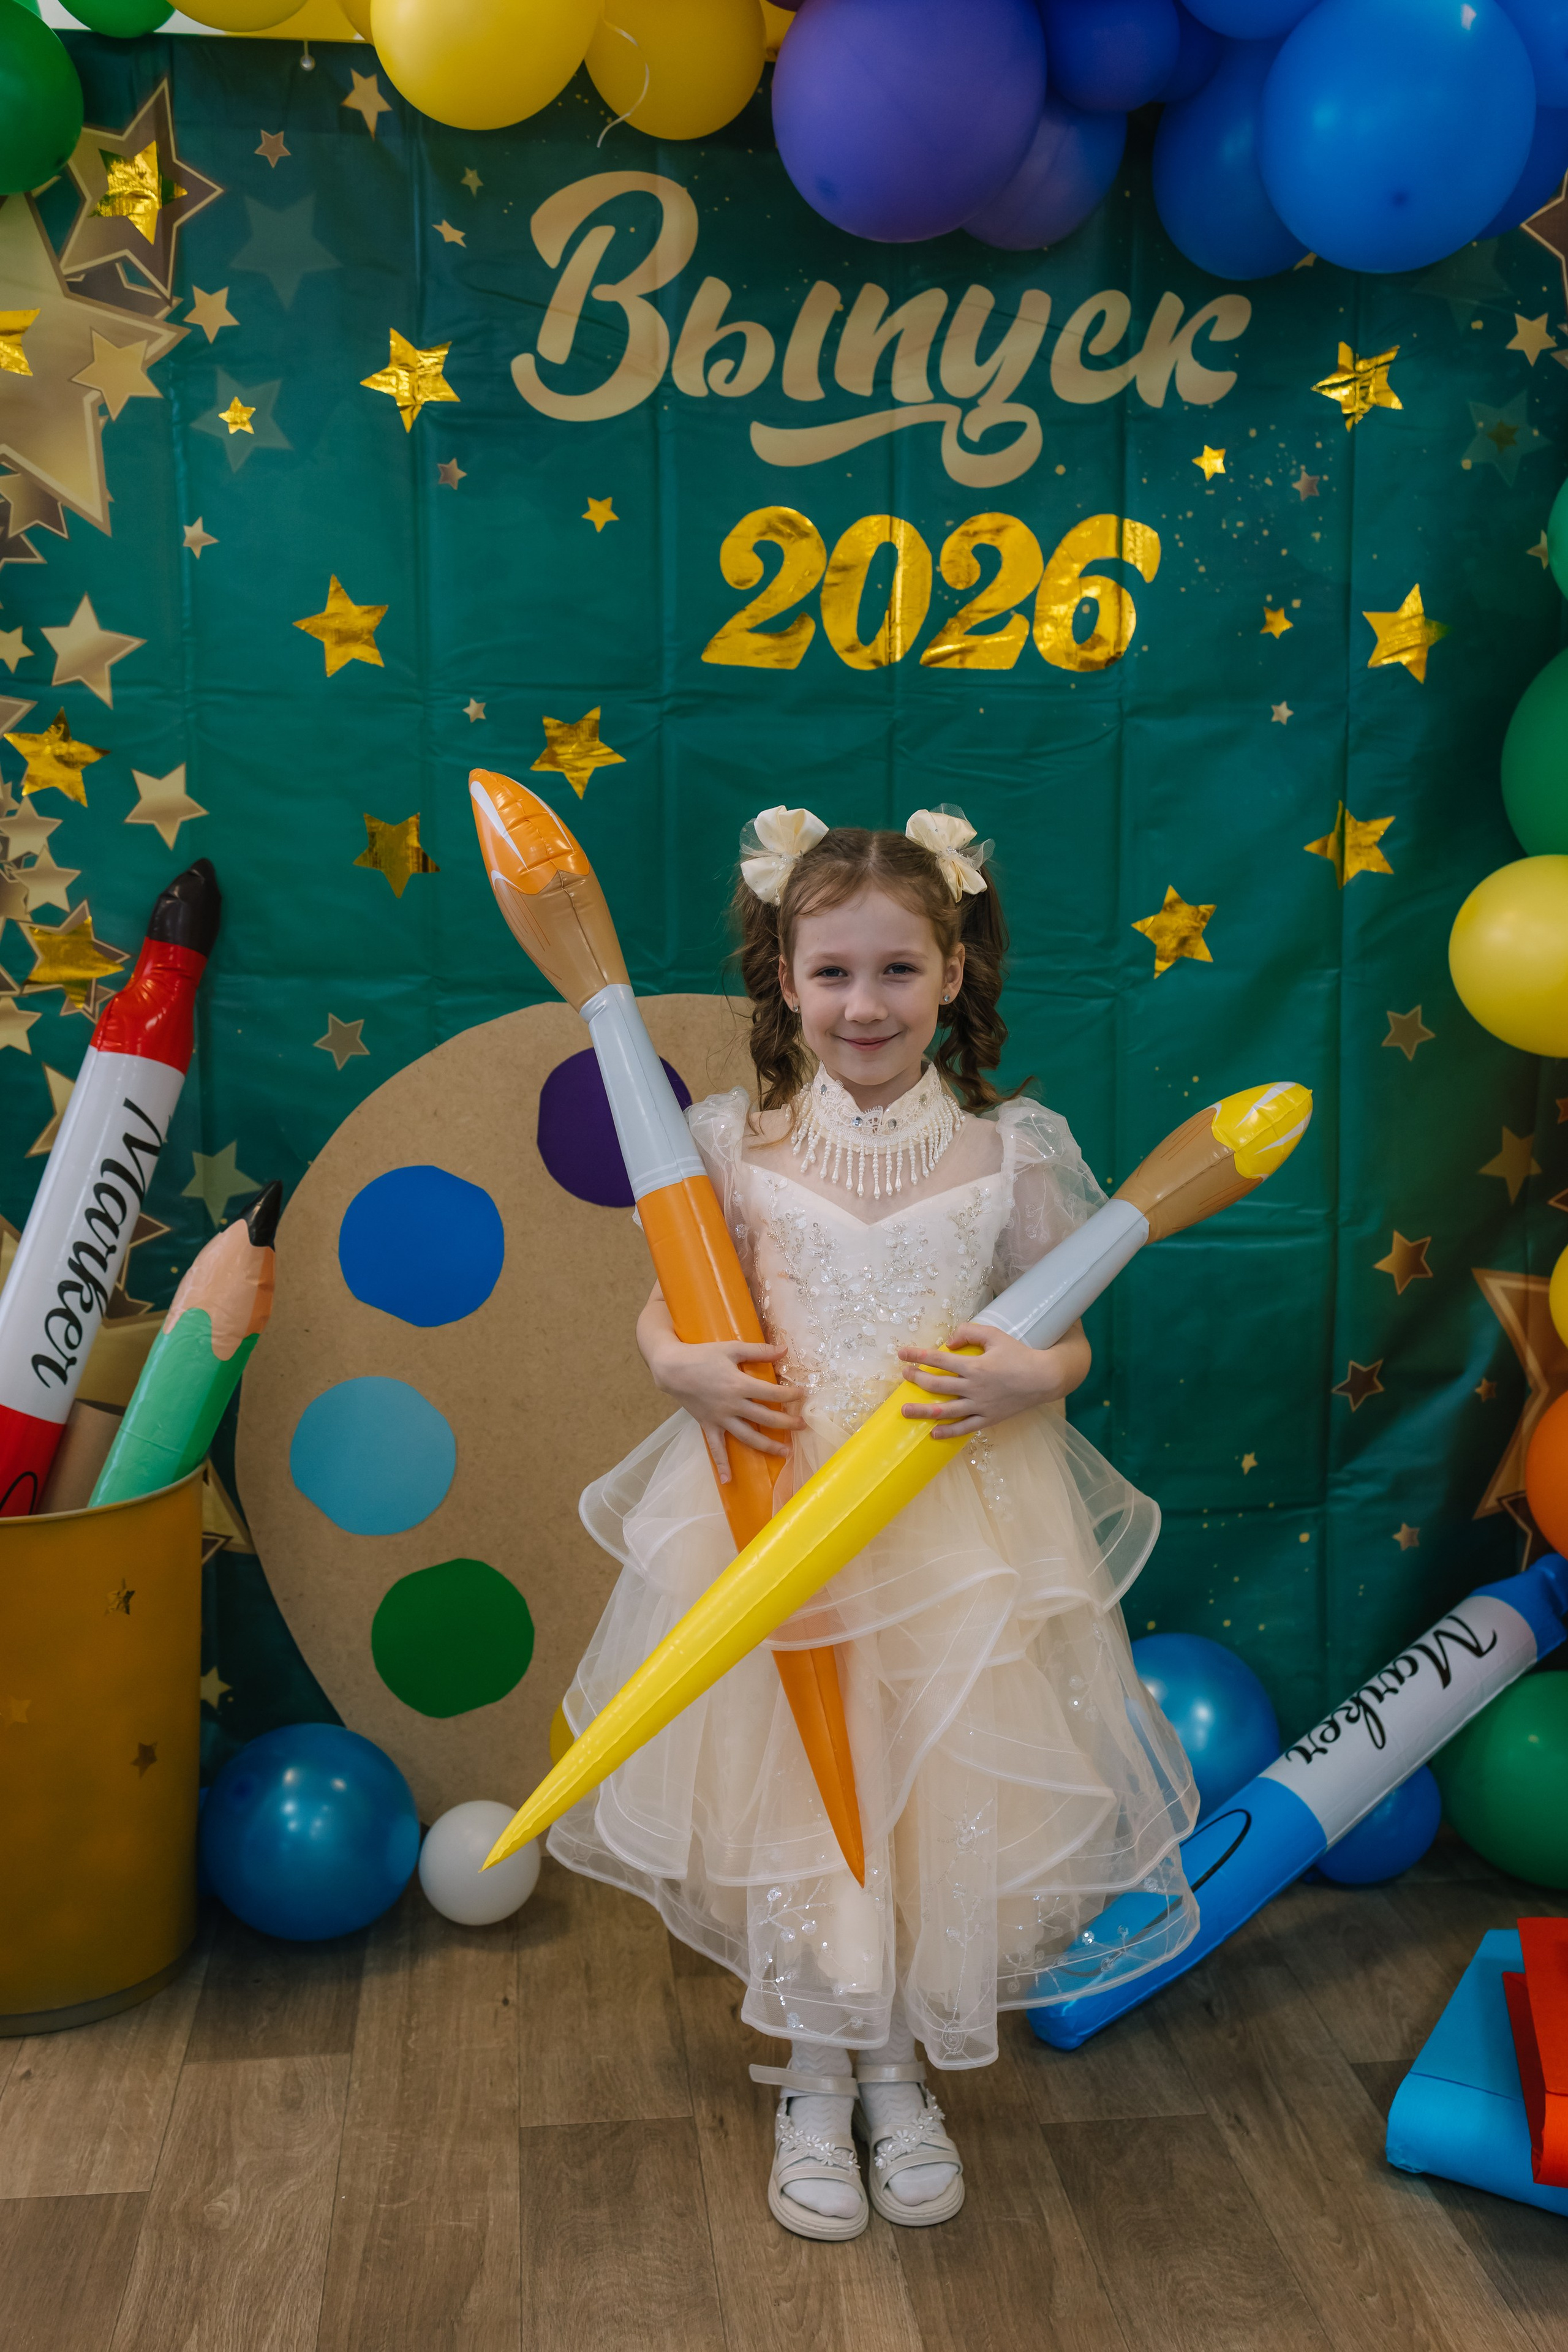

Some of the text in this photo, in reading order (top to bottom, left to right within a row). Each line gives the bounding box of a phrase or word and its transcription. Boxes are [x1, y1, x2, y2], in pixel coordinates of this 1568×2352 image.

[511, 171, 1252, 488] Выпуск
[701, 506, 1161, 672] 2026
[31, 1098, 163, 1389] Marker
[1286, 1615, 1497, 1765] Marker
